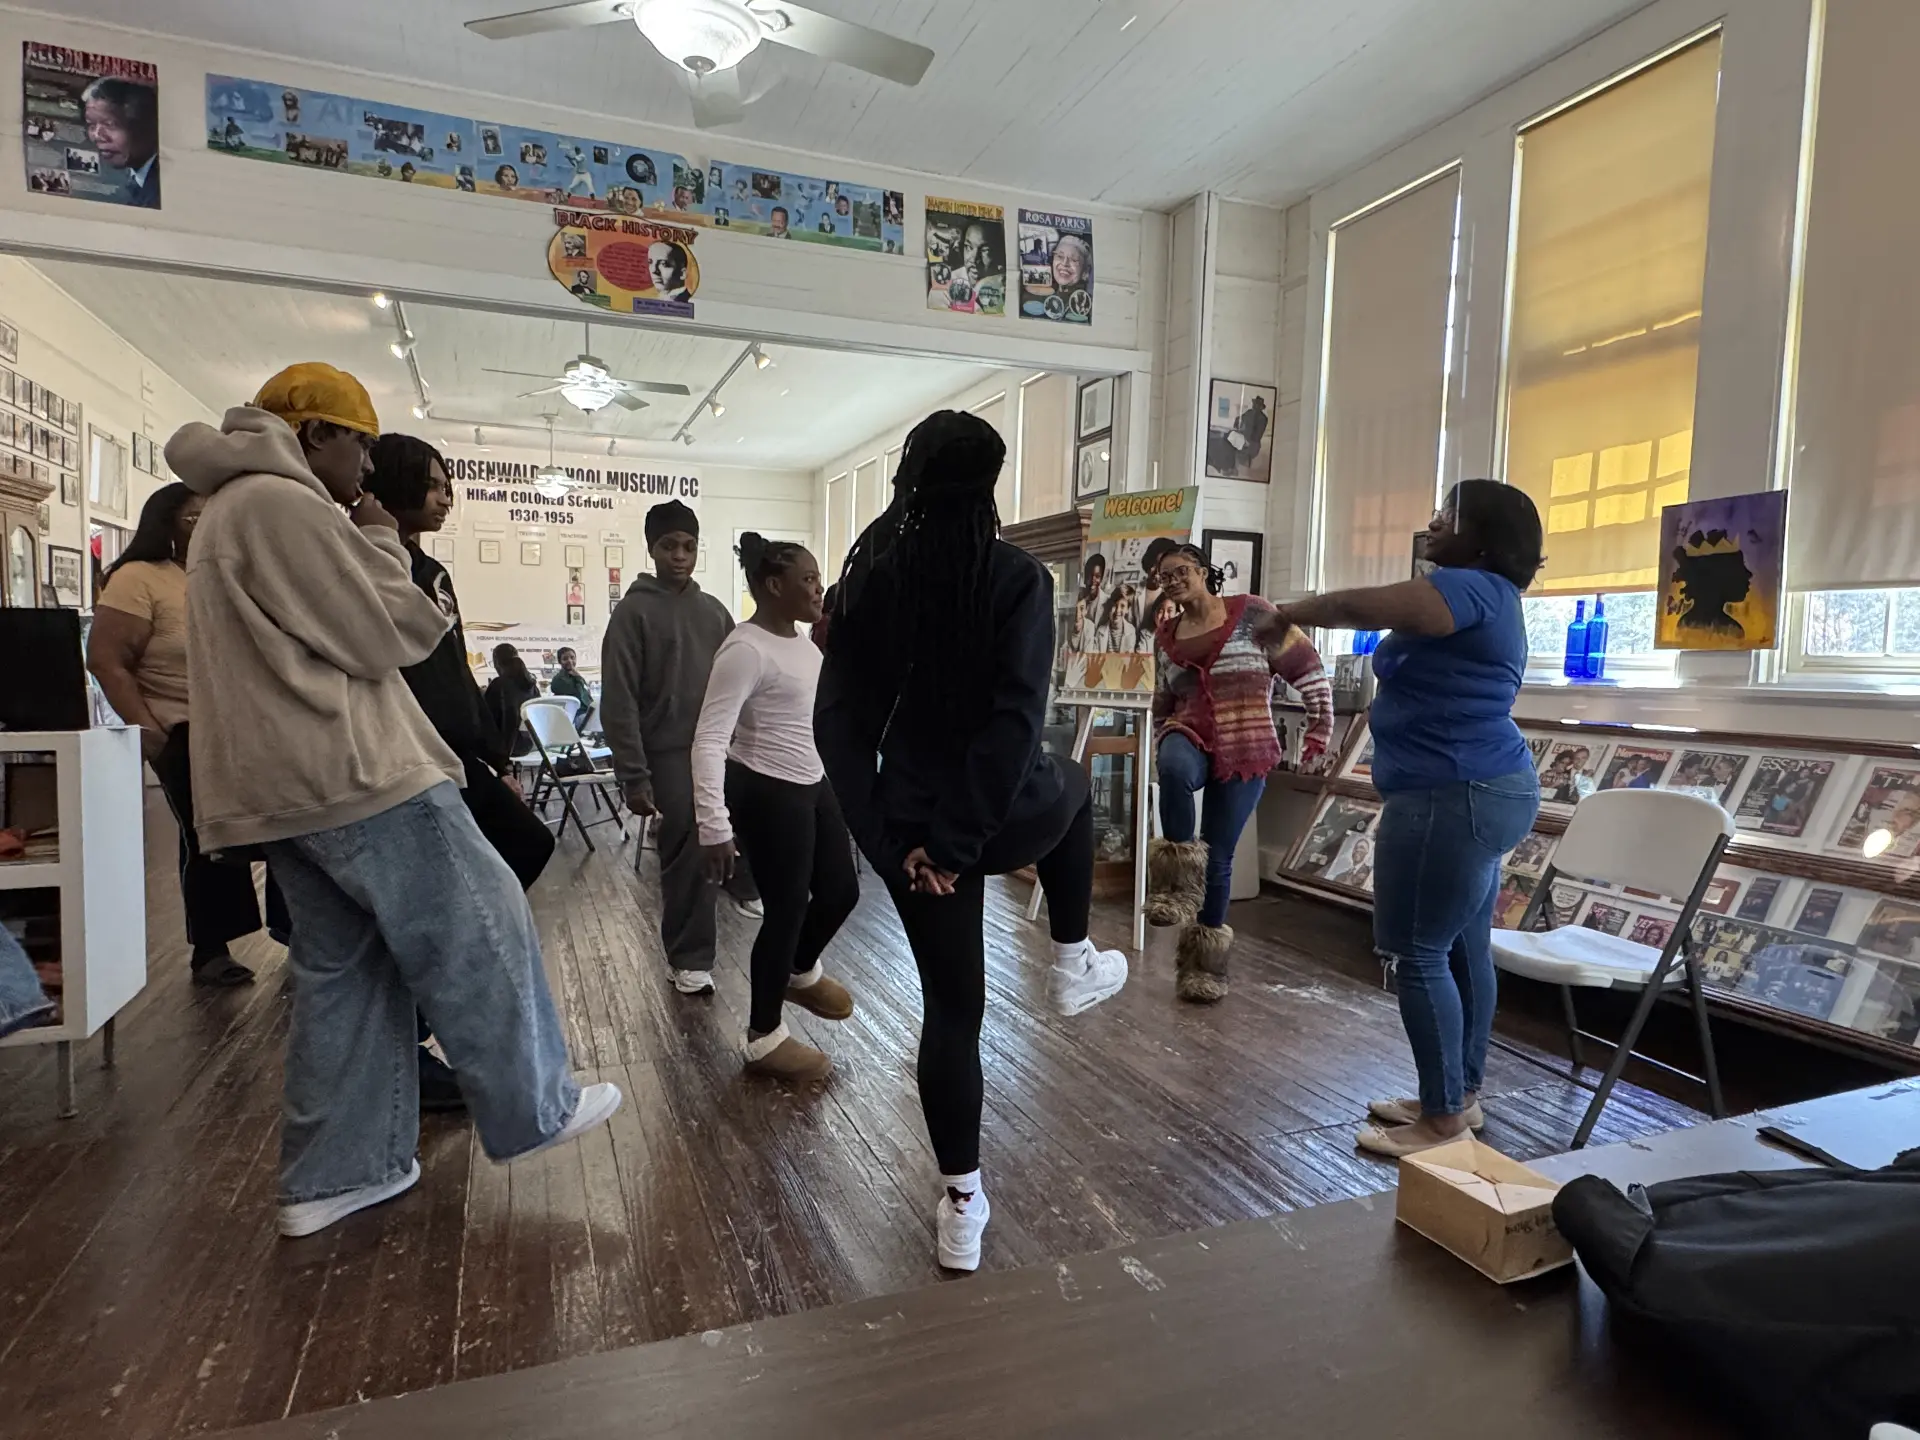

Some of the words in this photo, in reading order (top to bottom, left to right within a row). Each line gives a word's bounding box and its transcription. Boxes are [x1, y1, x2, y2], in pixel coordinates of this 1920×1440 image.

[554, 209, 617, 233] BLACK
[621, 219, 699, 245] HISTORY
[1025, 211, 1051, 225] ROSA
[1055, 217, 1086, 230] PARKS
[679, 477, 699, 497] CC
[466, 488, 508, 502] HIRAM
[567, 494, 614, 510] SCHOOL
[1104, 488, 1184, 519] Welcome!
[508, 509, 574, 524] 1930-1955
[1635, 917, 1655, 929] JET
